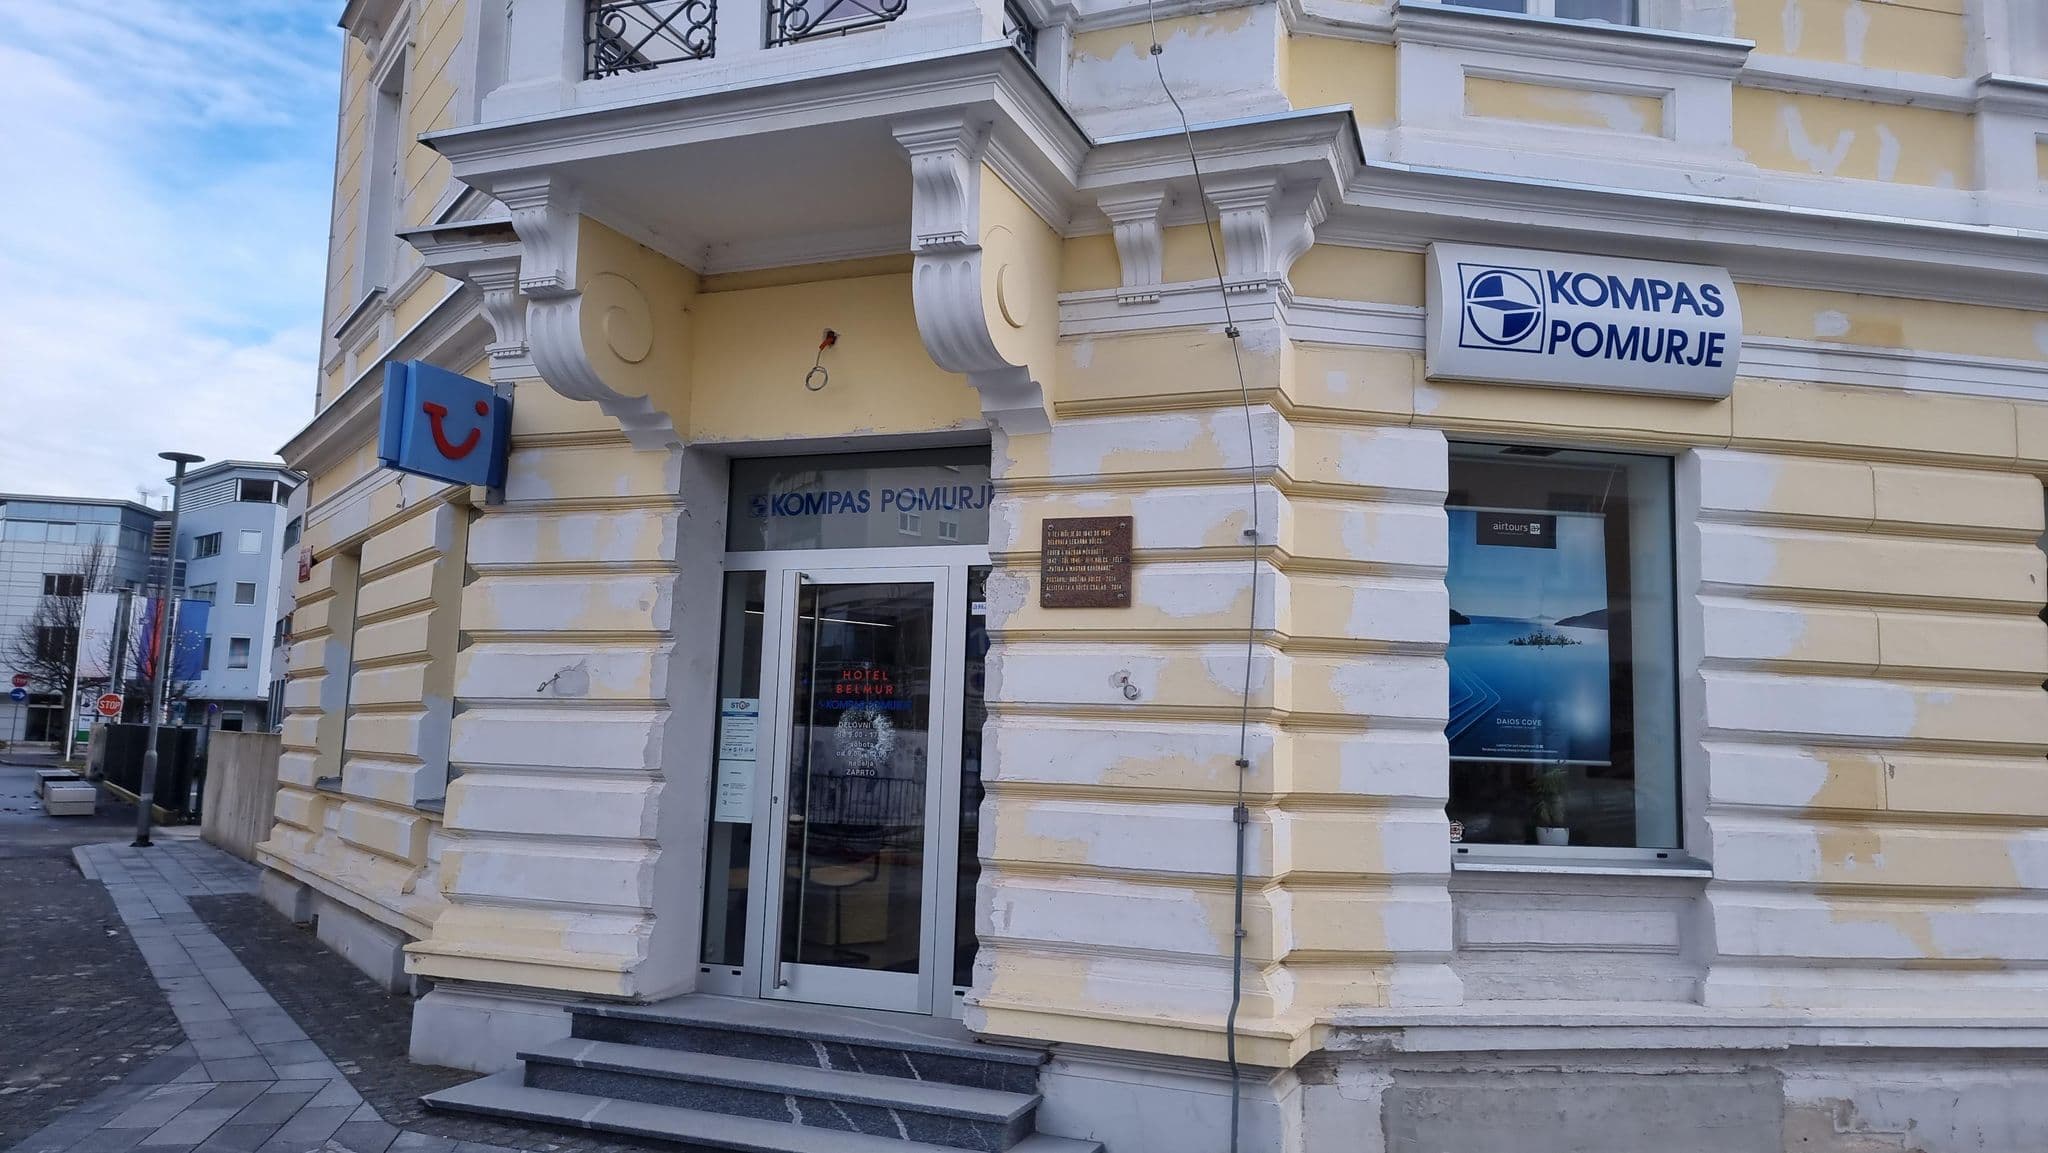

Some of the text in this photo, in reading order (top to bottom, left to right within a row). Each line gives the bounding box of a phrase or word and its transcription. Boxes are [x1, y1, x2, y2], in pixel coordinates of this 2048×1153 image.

[1547, 270, 1725, 318] KOMPAS
[1548, 319, 1726, 367] POMURJE
[771, 488, 870, 517] KOMPAS
[1493, 522, 1529, 533] airtours
[843, 670, 888, 680] HOTEL
[836, 684, 894, 695] BELMUR
[100, 700, 121, 710] STOP
[838, 721, 871, 729] DELOVNI
[1496, 718, 1520, 726] DAIOS
[1521, 719, 1542, 727] COVE
[846, 769, 875, 777] ZAPRTO
